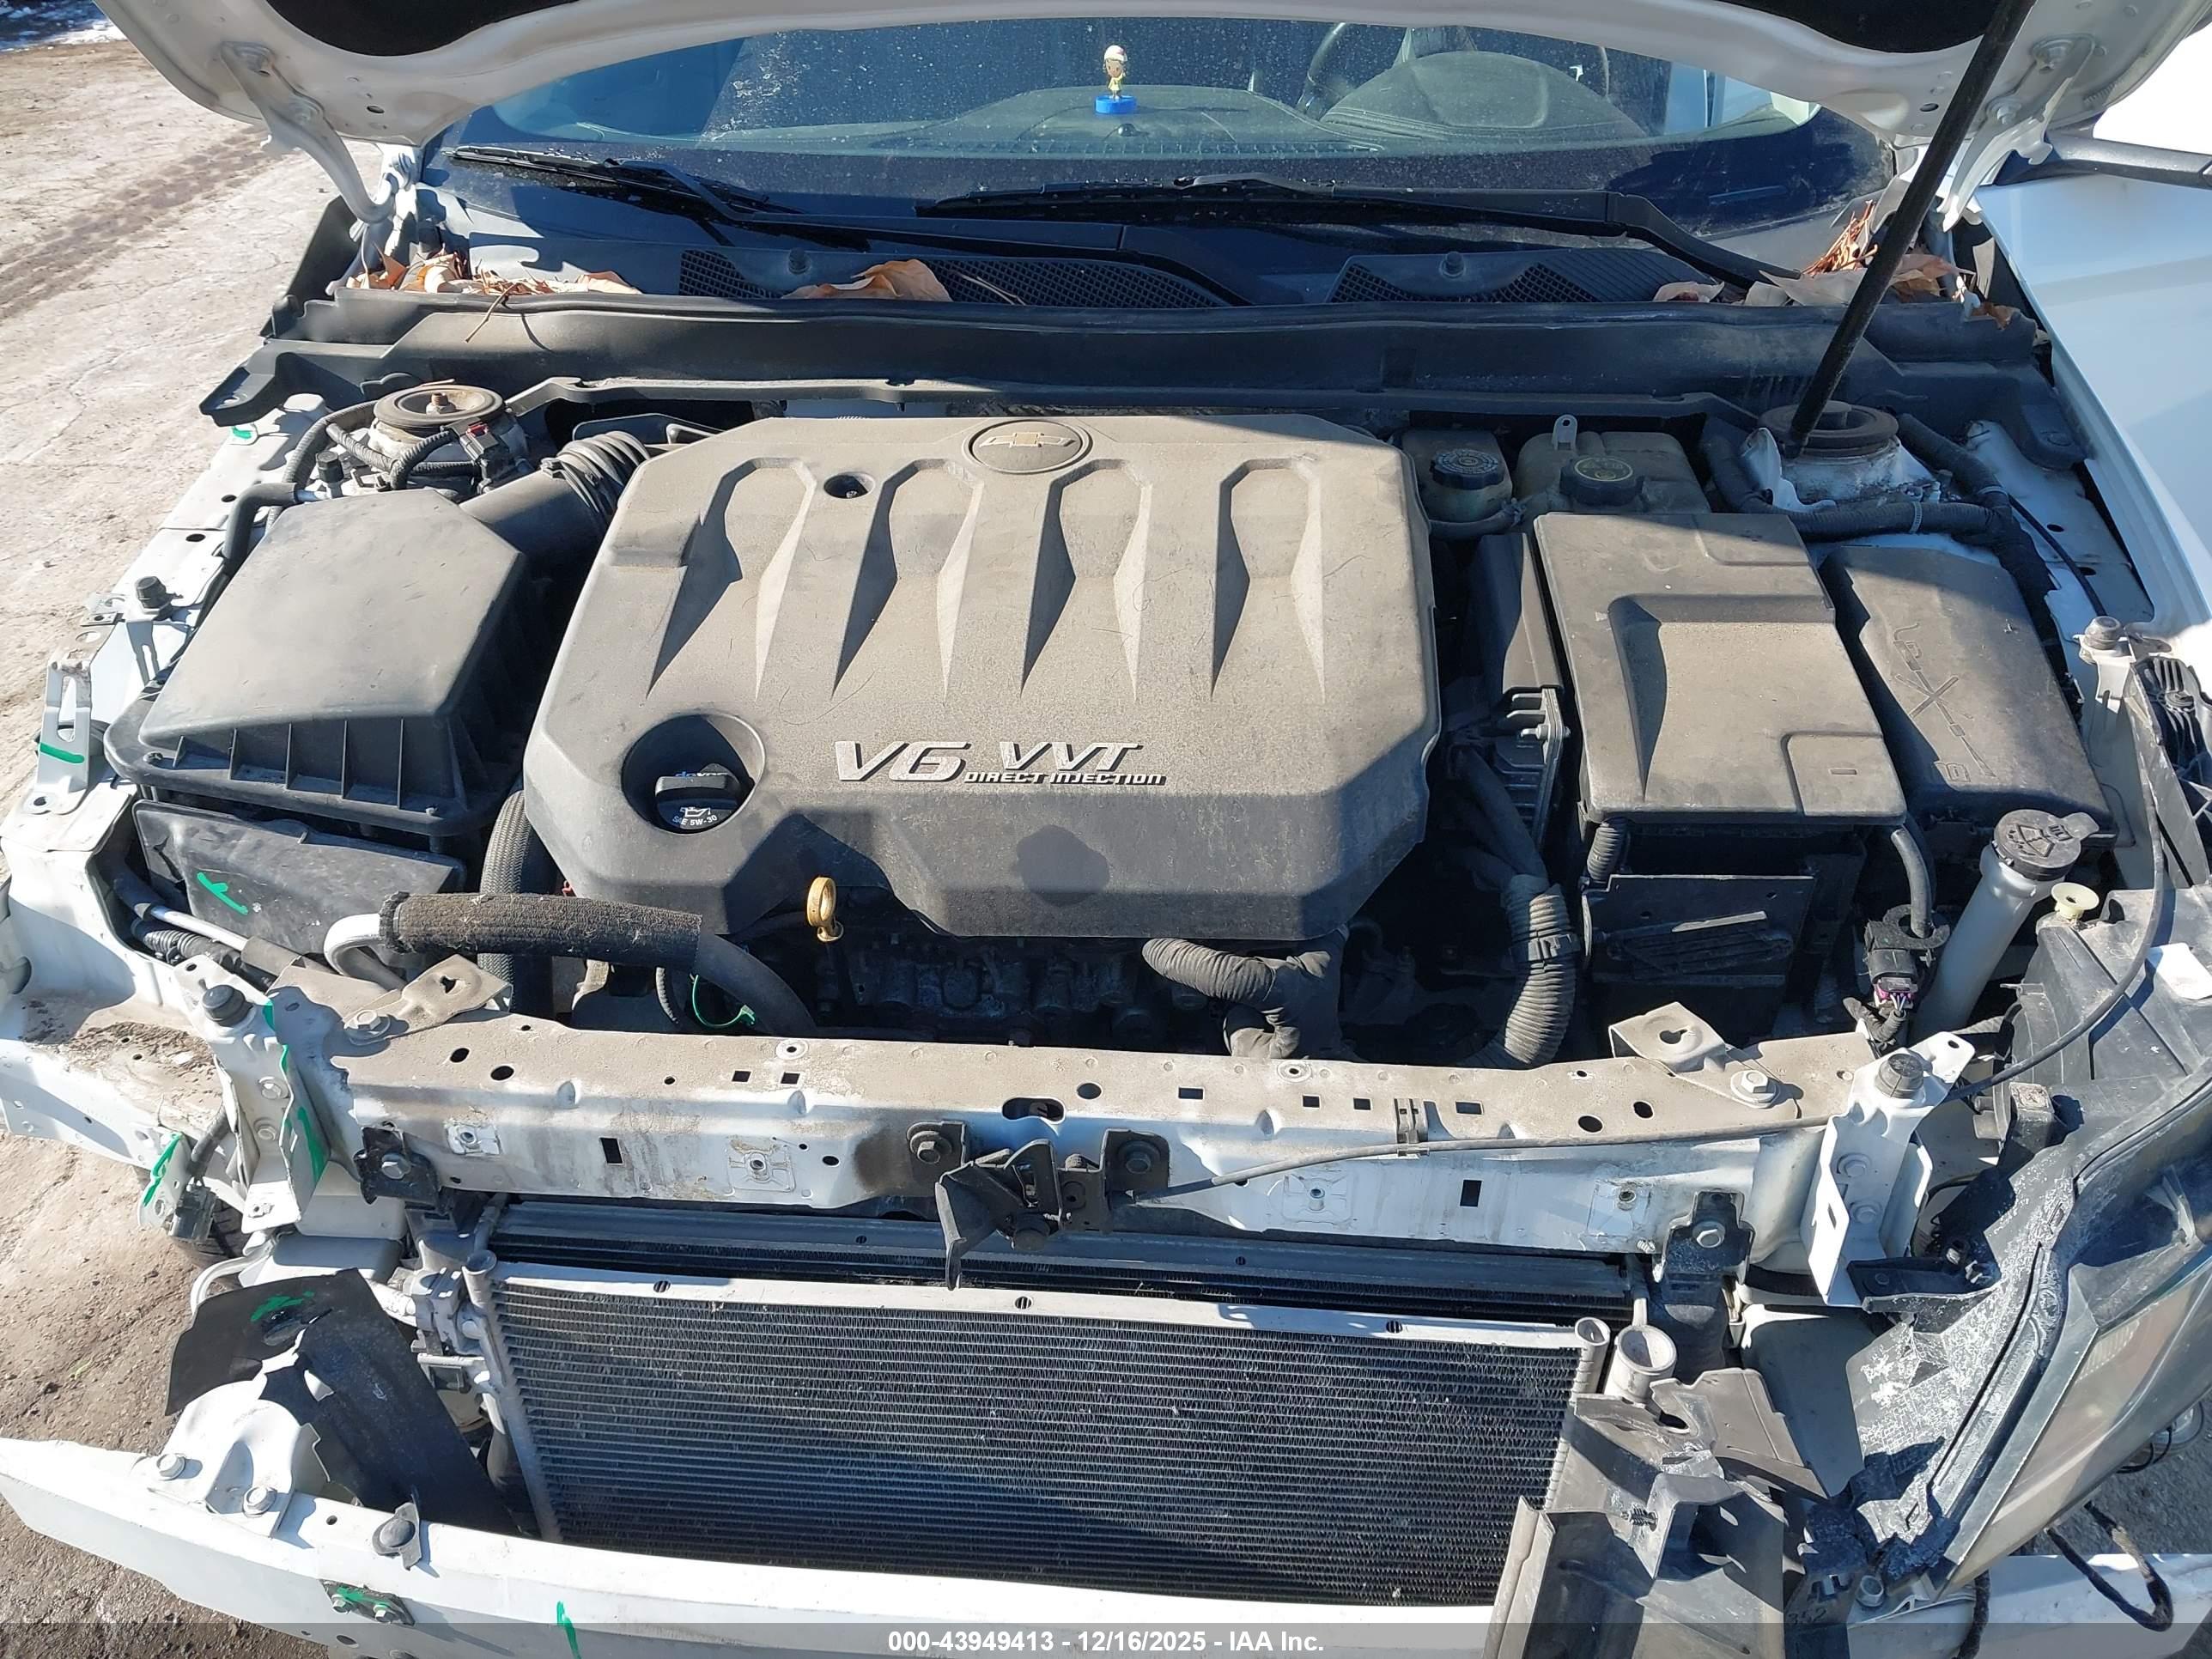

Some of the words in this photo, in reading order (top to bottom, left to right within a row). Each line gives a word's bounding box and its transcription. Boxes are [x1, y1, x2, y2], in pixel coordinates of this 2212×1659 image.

[836, 741, 969, 781] V6
[1000, 741, 1141, 770] VVT
[964, 772, 1044, 784] DIRECT
[672, 815, 688, 825] SAE
[690, 815, 718, 826] 5W-30
